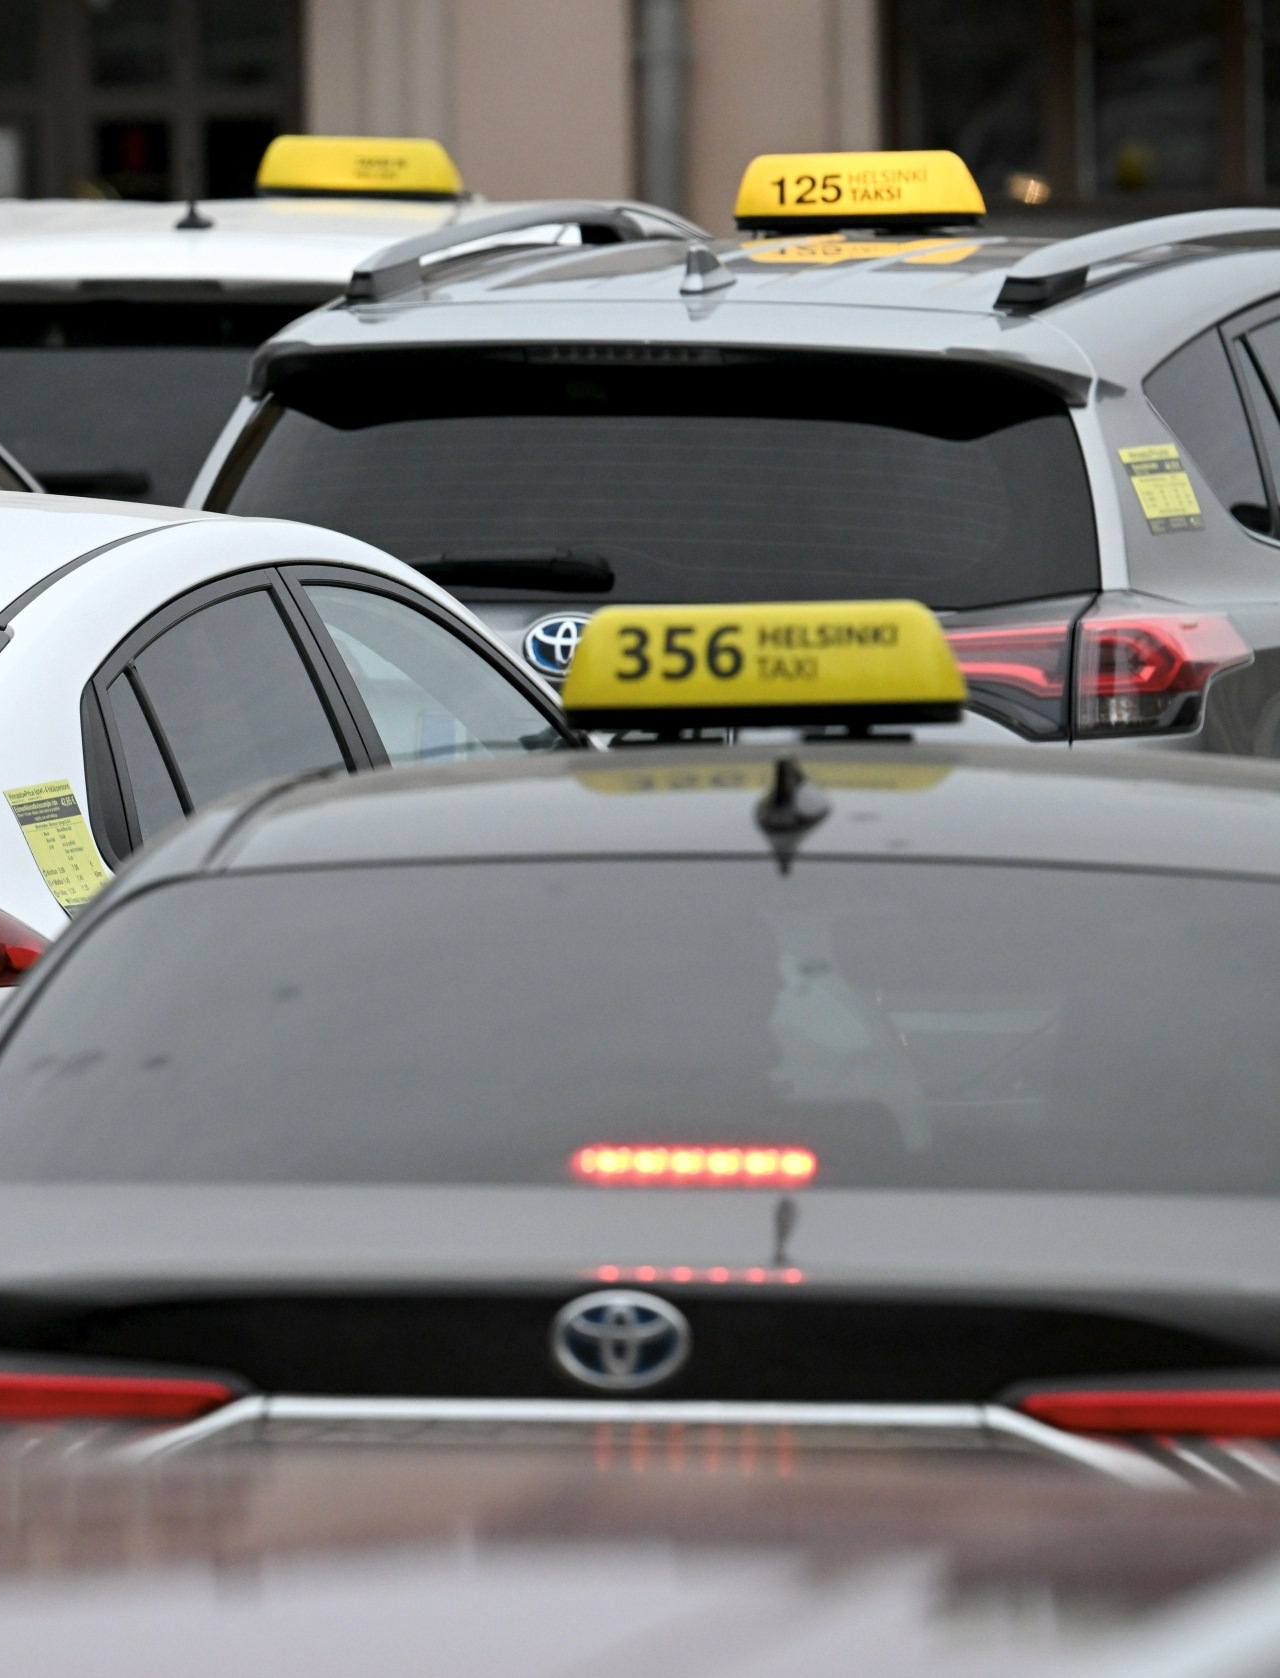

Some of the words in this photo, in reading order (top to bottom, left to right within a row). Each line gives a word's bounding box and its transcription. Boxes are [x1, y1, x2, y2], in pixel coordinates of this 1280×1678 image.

[847, 168, 928, 184] HELSINKI
[771, 174, 842, 206] 125
[850, 187, 902, 203] TAKSI
[757, 623, 899, 648] HELSINKI
[616, 624, 744, 682] 356
[756, 656, 818, 680] TAXI
